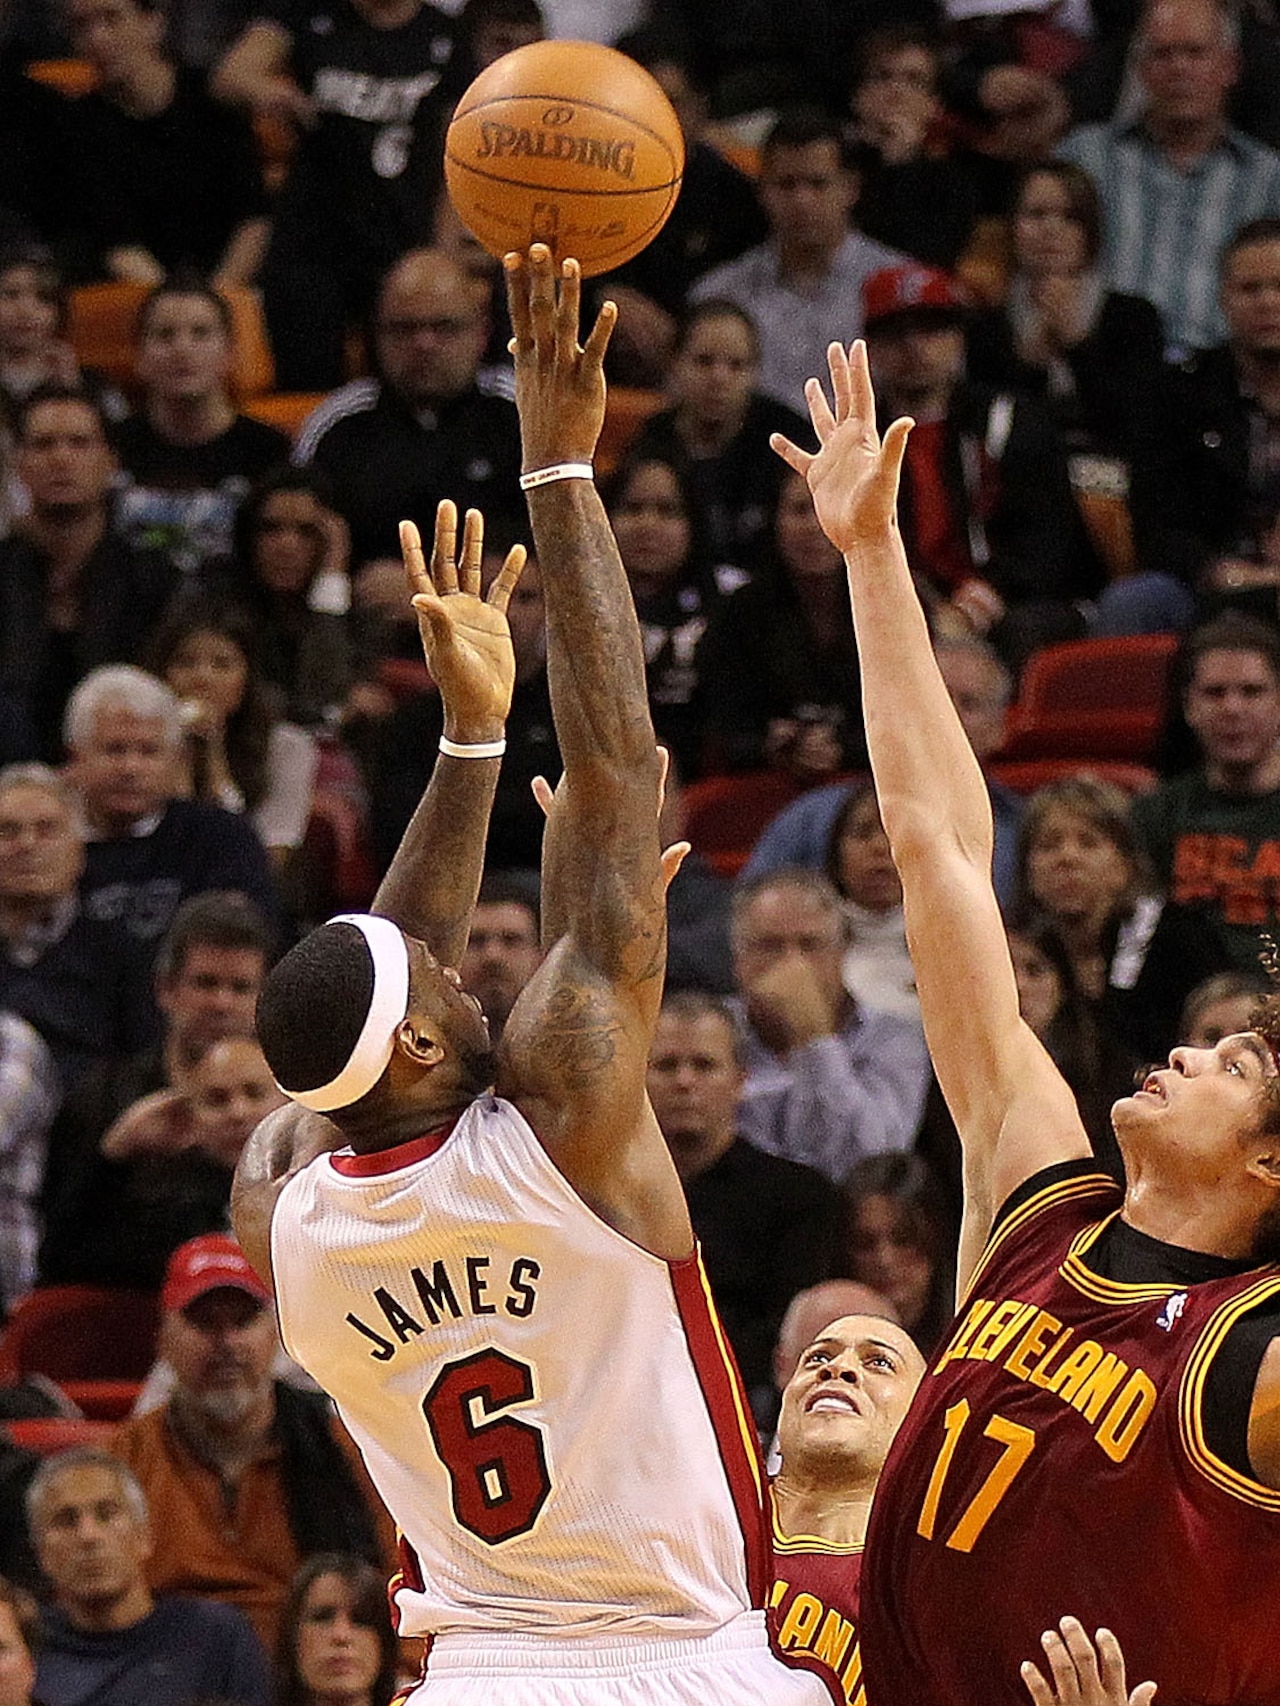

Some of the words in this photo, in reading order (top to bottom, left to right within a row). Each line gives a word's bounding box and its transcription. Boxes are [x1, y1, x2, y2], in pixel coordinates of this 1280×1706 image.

[477, 121, 636, 182] SPALDING
[345, 1256, 542, 1362] JAMES
[421, 1345, 554, 1548] 6
[916, 1397, 1036, 1553] 17
